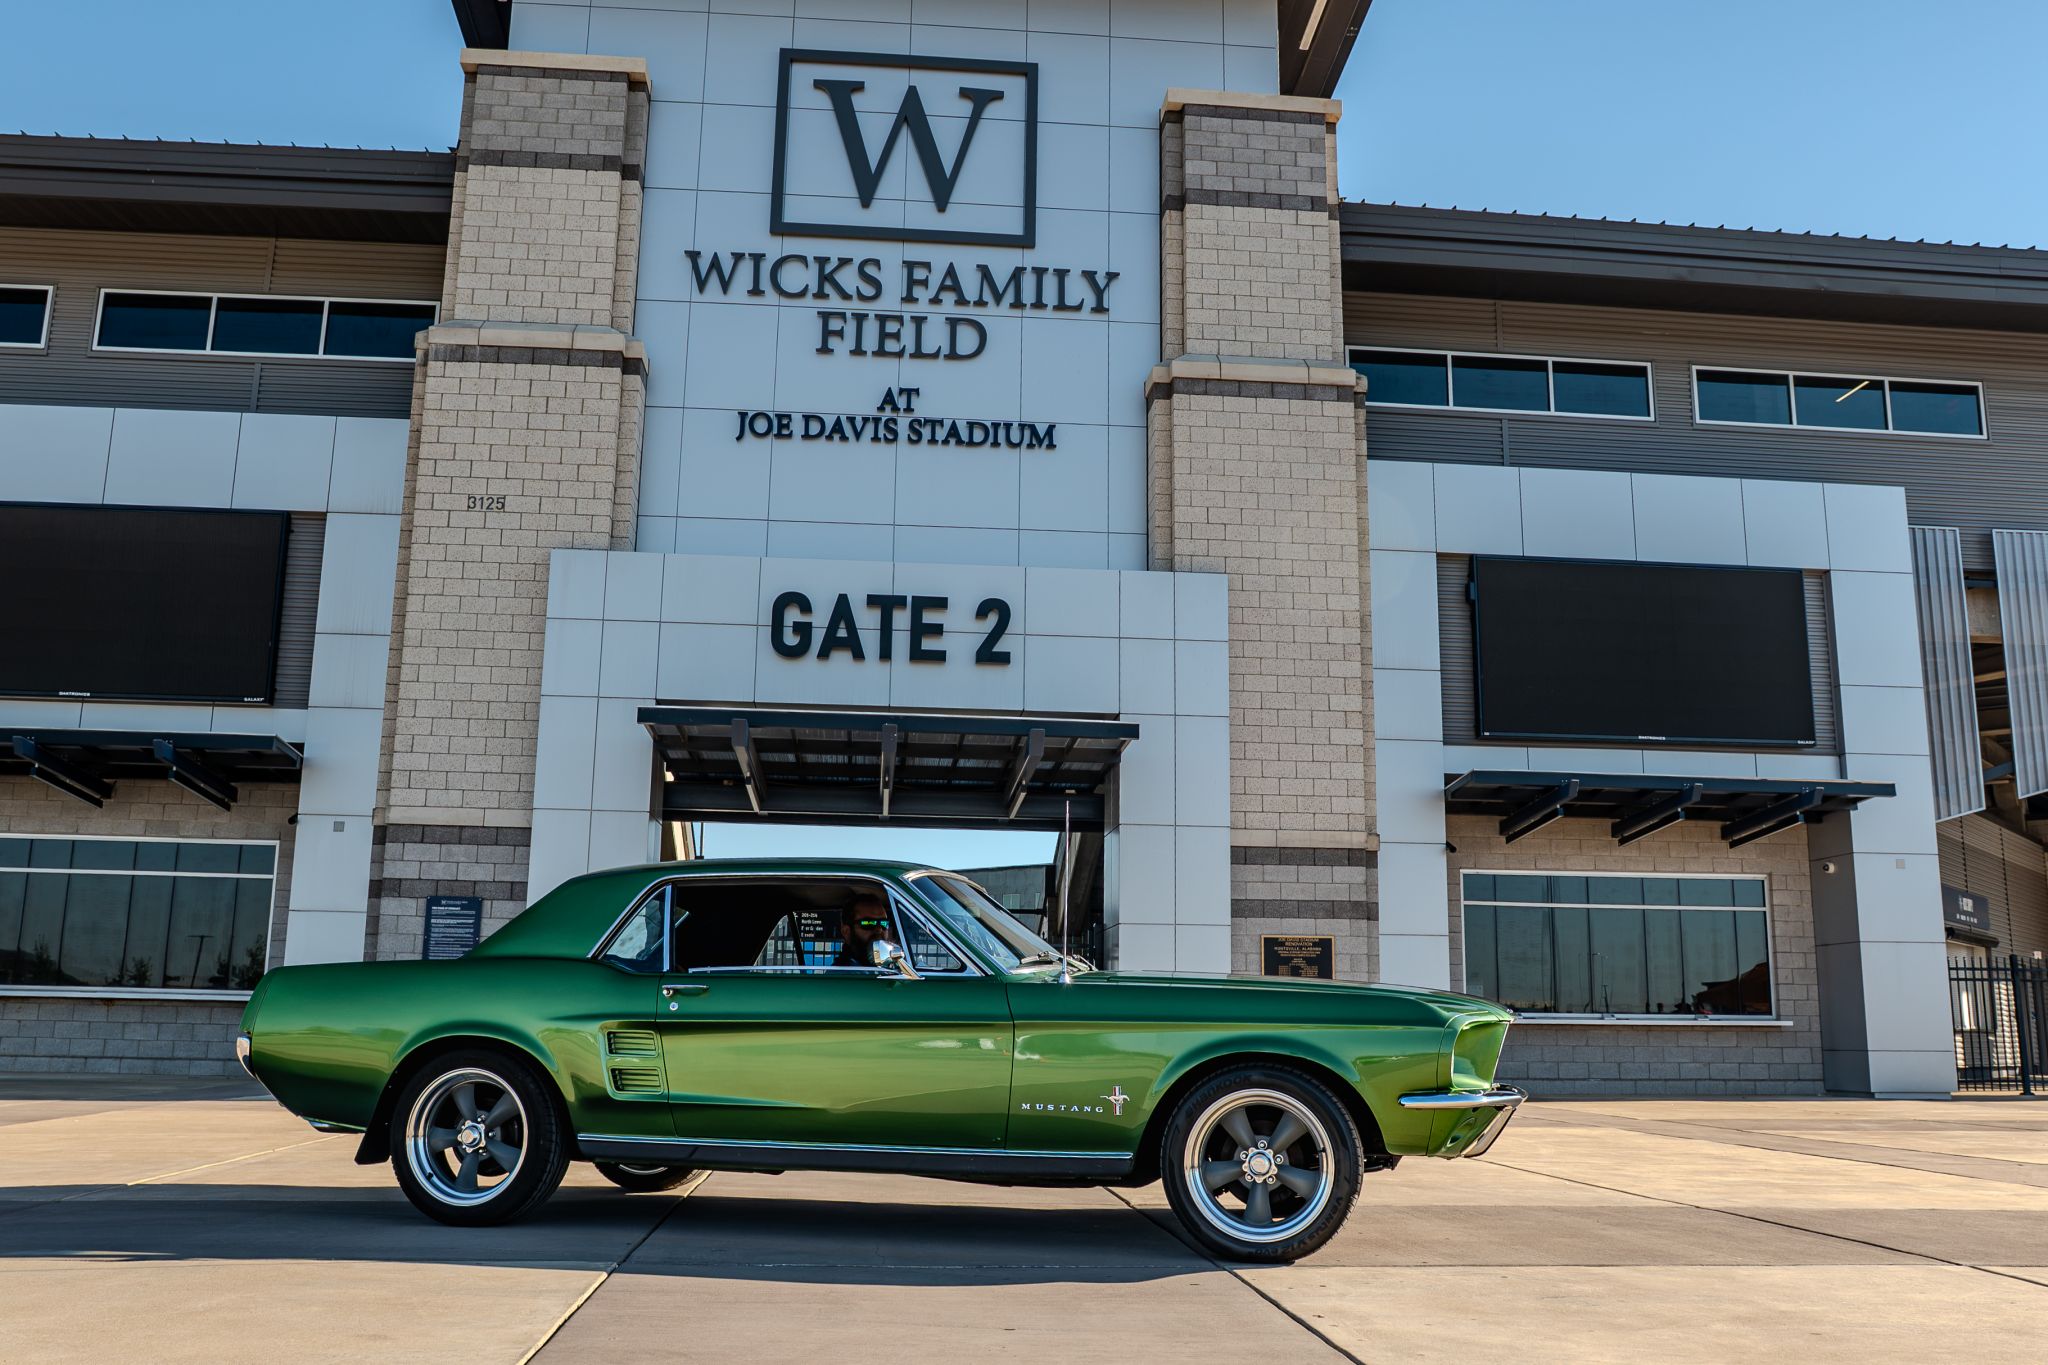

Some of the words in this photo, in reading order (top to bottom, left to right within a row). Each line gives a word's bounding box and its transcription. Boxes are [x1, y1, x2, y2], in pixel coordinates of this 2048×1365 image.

[813, 79, 1004, 212] W
[684, 250, 883, 300] WICKS
[901, 260, 1121, 313] FAMILY
[815, 310, 988, 360] FIELD
[876, 387, 920, 413] AT
[735, 411, 793, 442] JOE
[801, 415, 898, 444] DAVIS
[906, 418, 1057, 450] STADIUM
[468, 496, 505, 510] 3125
[771, 591, 949, 663] GATE
[975, 597, 1012, 665] 2
[1021, 1103, 1103, 1113] MUSTANG
